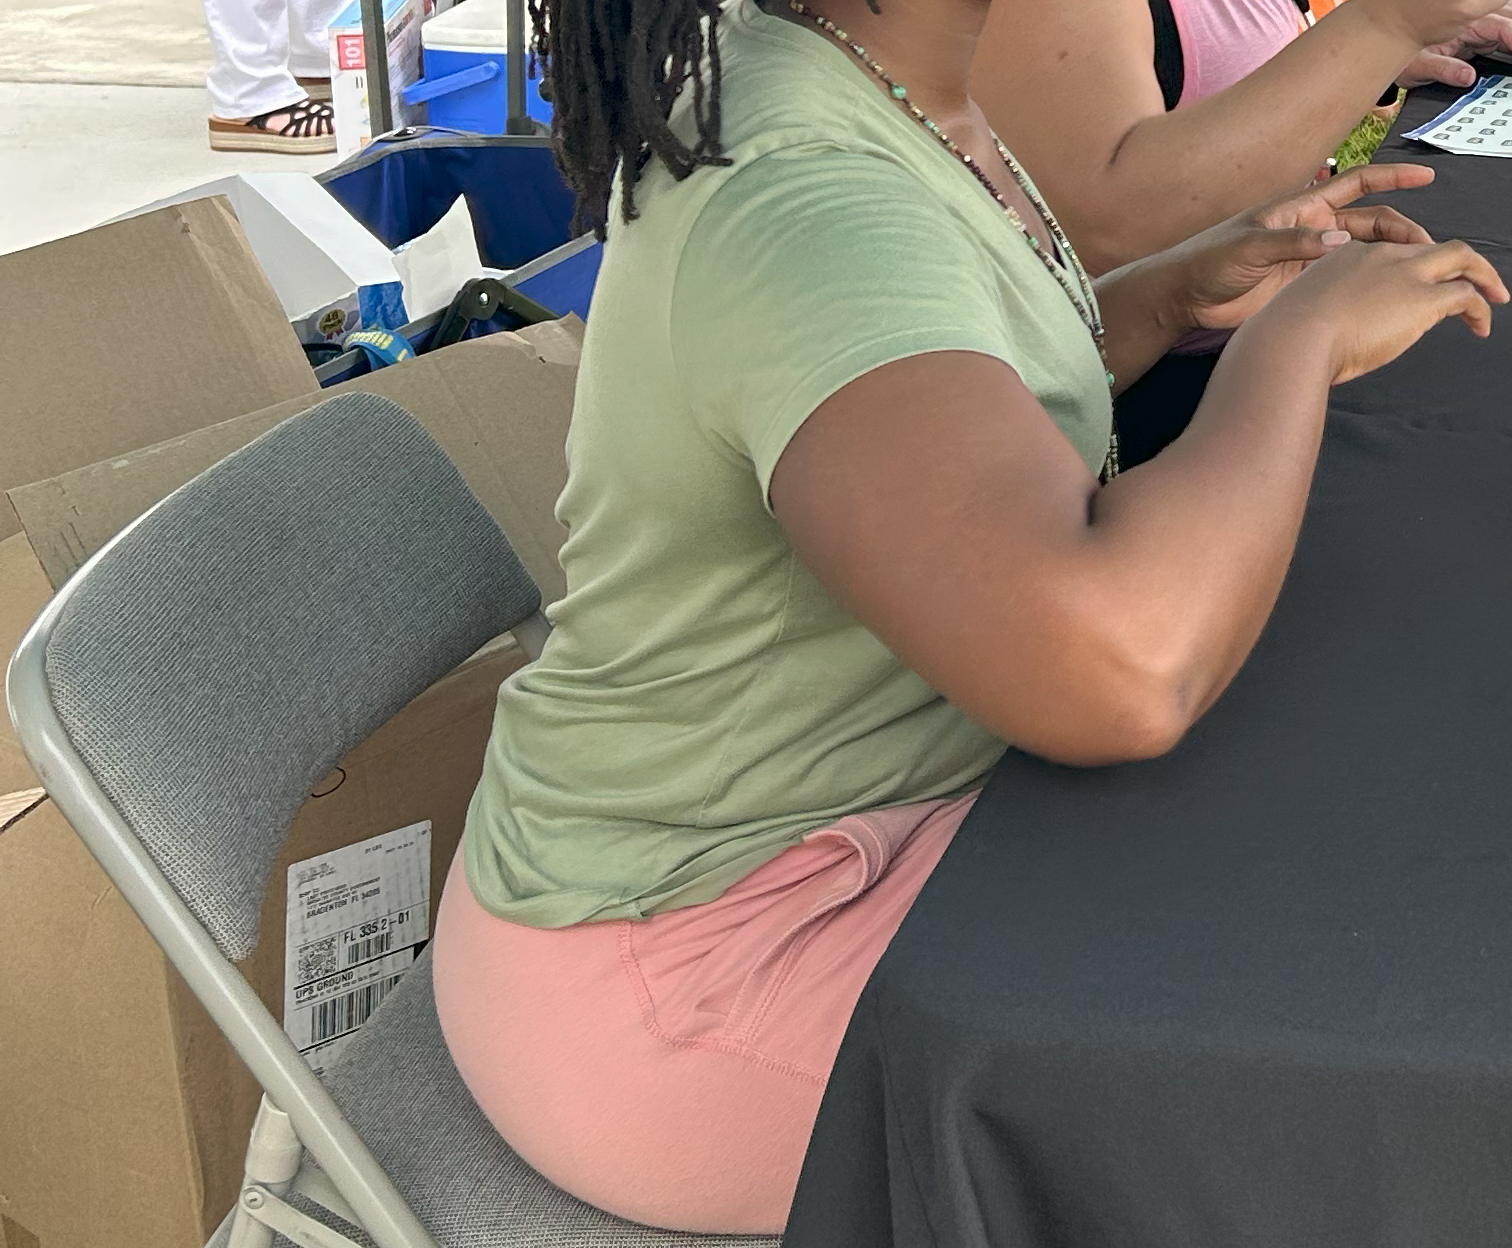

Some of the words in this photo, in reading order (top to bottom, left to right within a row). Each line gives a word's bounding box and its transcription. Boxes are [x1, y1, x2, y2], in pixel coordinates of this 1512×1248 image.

[345, 38, 362, 68] 101
[343, 931, 357, 944] FL
[295, 986, 315, 1000] UPS
[316, 971, 355, 992] GROUND
